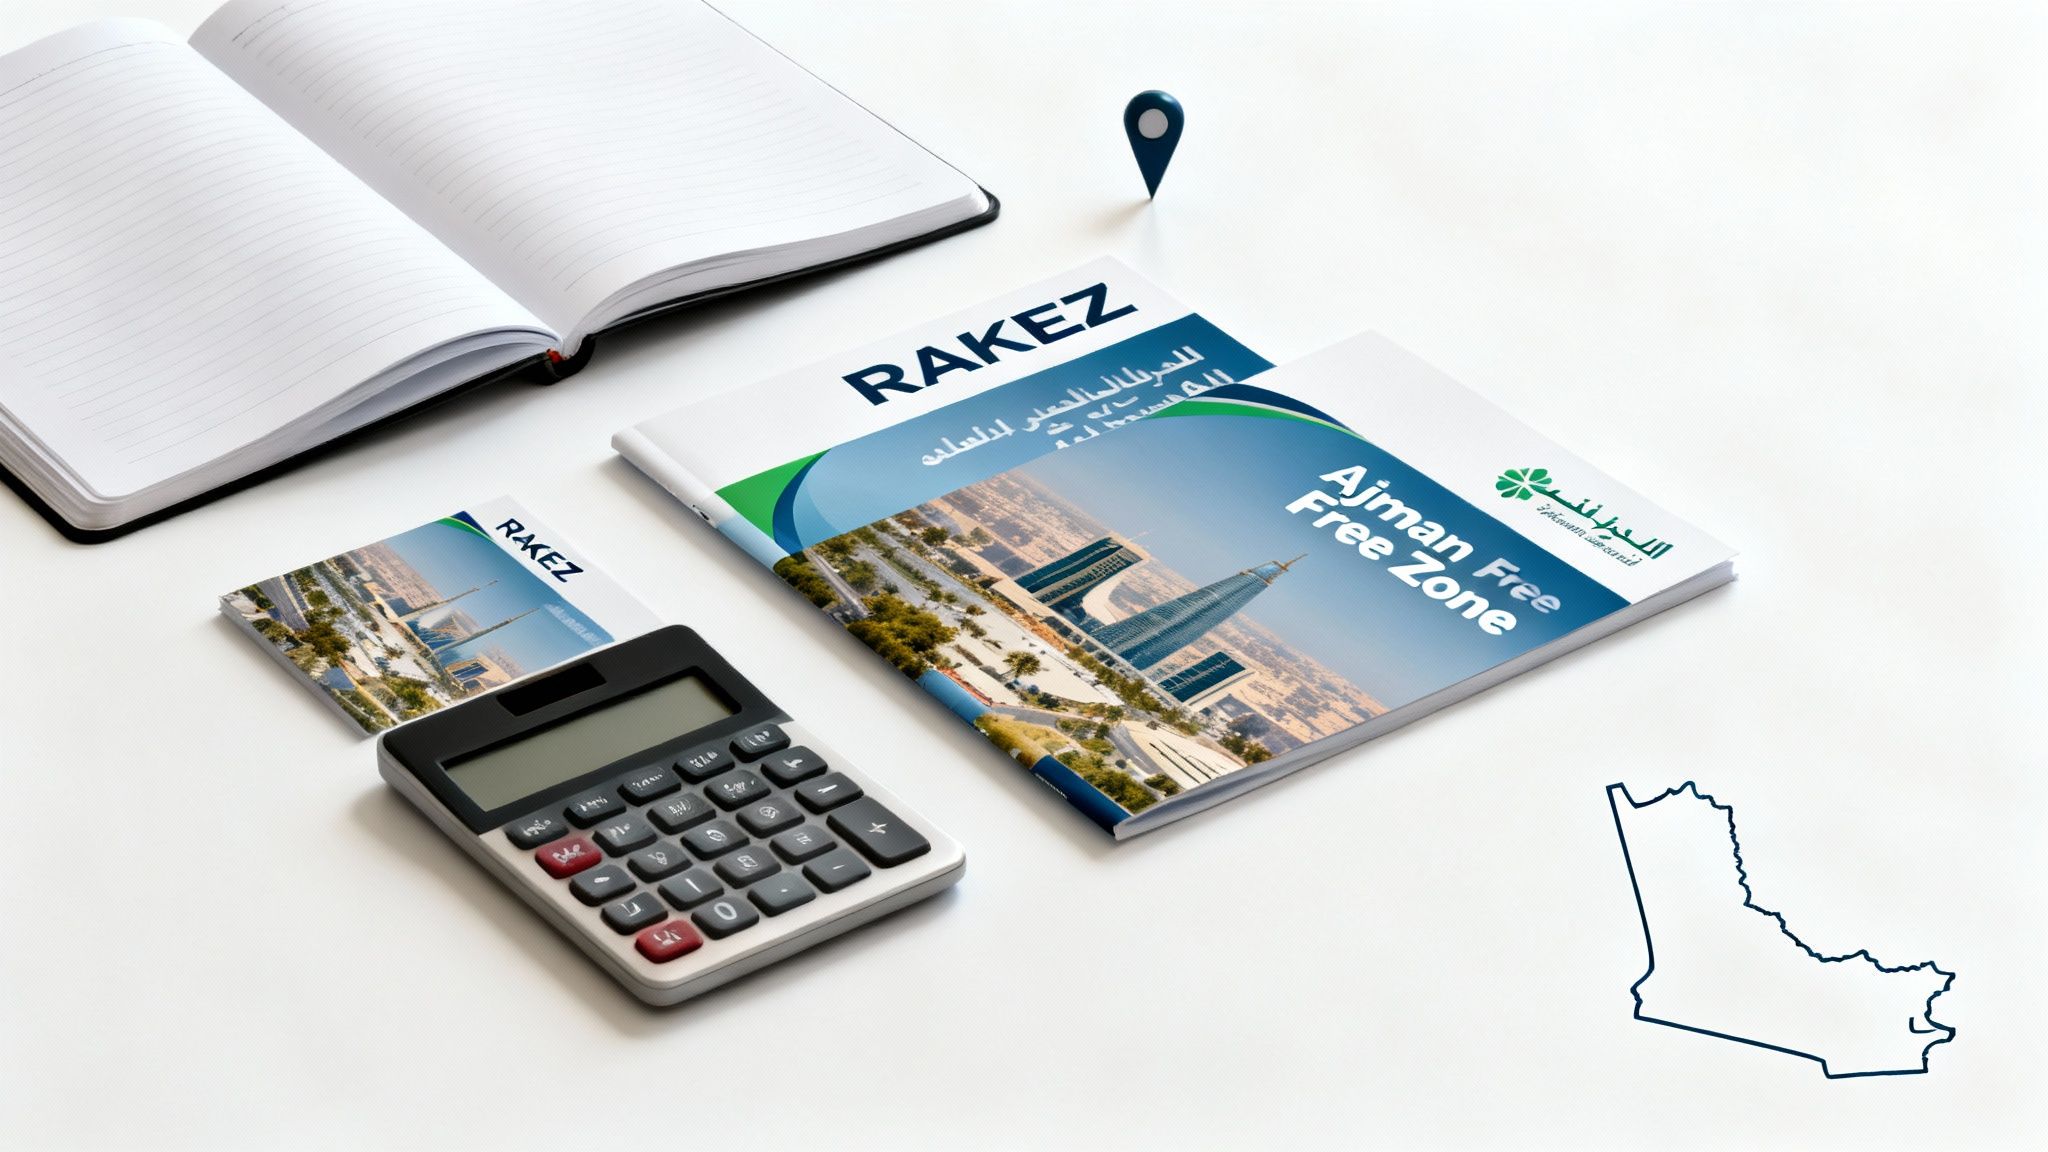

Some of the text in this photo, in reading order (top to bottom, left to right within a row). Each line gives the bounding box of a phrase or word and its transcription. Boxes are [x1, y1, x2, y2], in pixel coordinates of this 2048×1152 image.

[841, 282, 1139, 406] RAKEZ
[495, 518, 584, 583] RAKEZ
[1284, 489, 1518, 636] Free Zone
[1319, 464, 1474, 563] Ajman
[1472, 557, 1561, 614] Free
